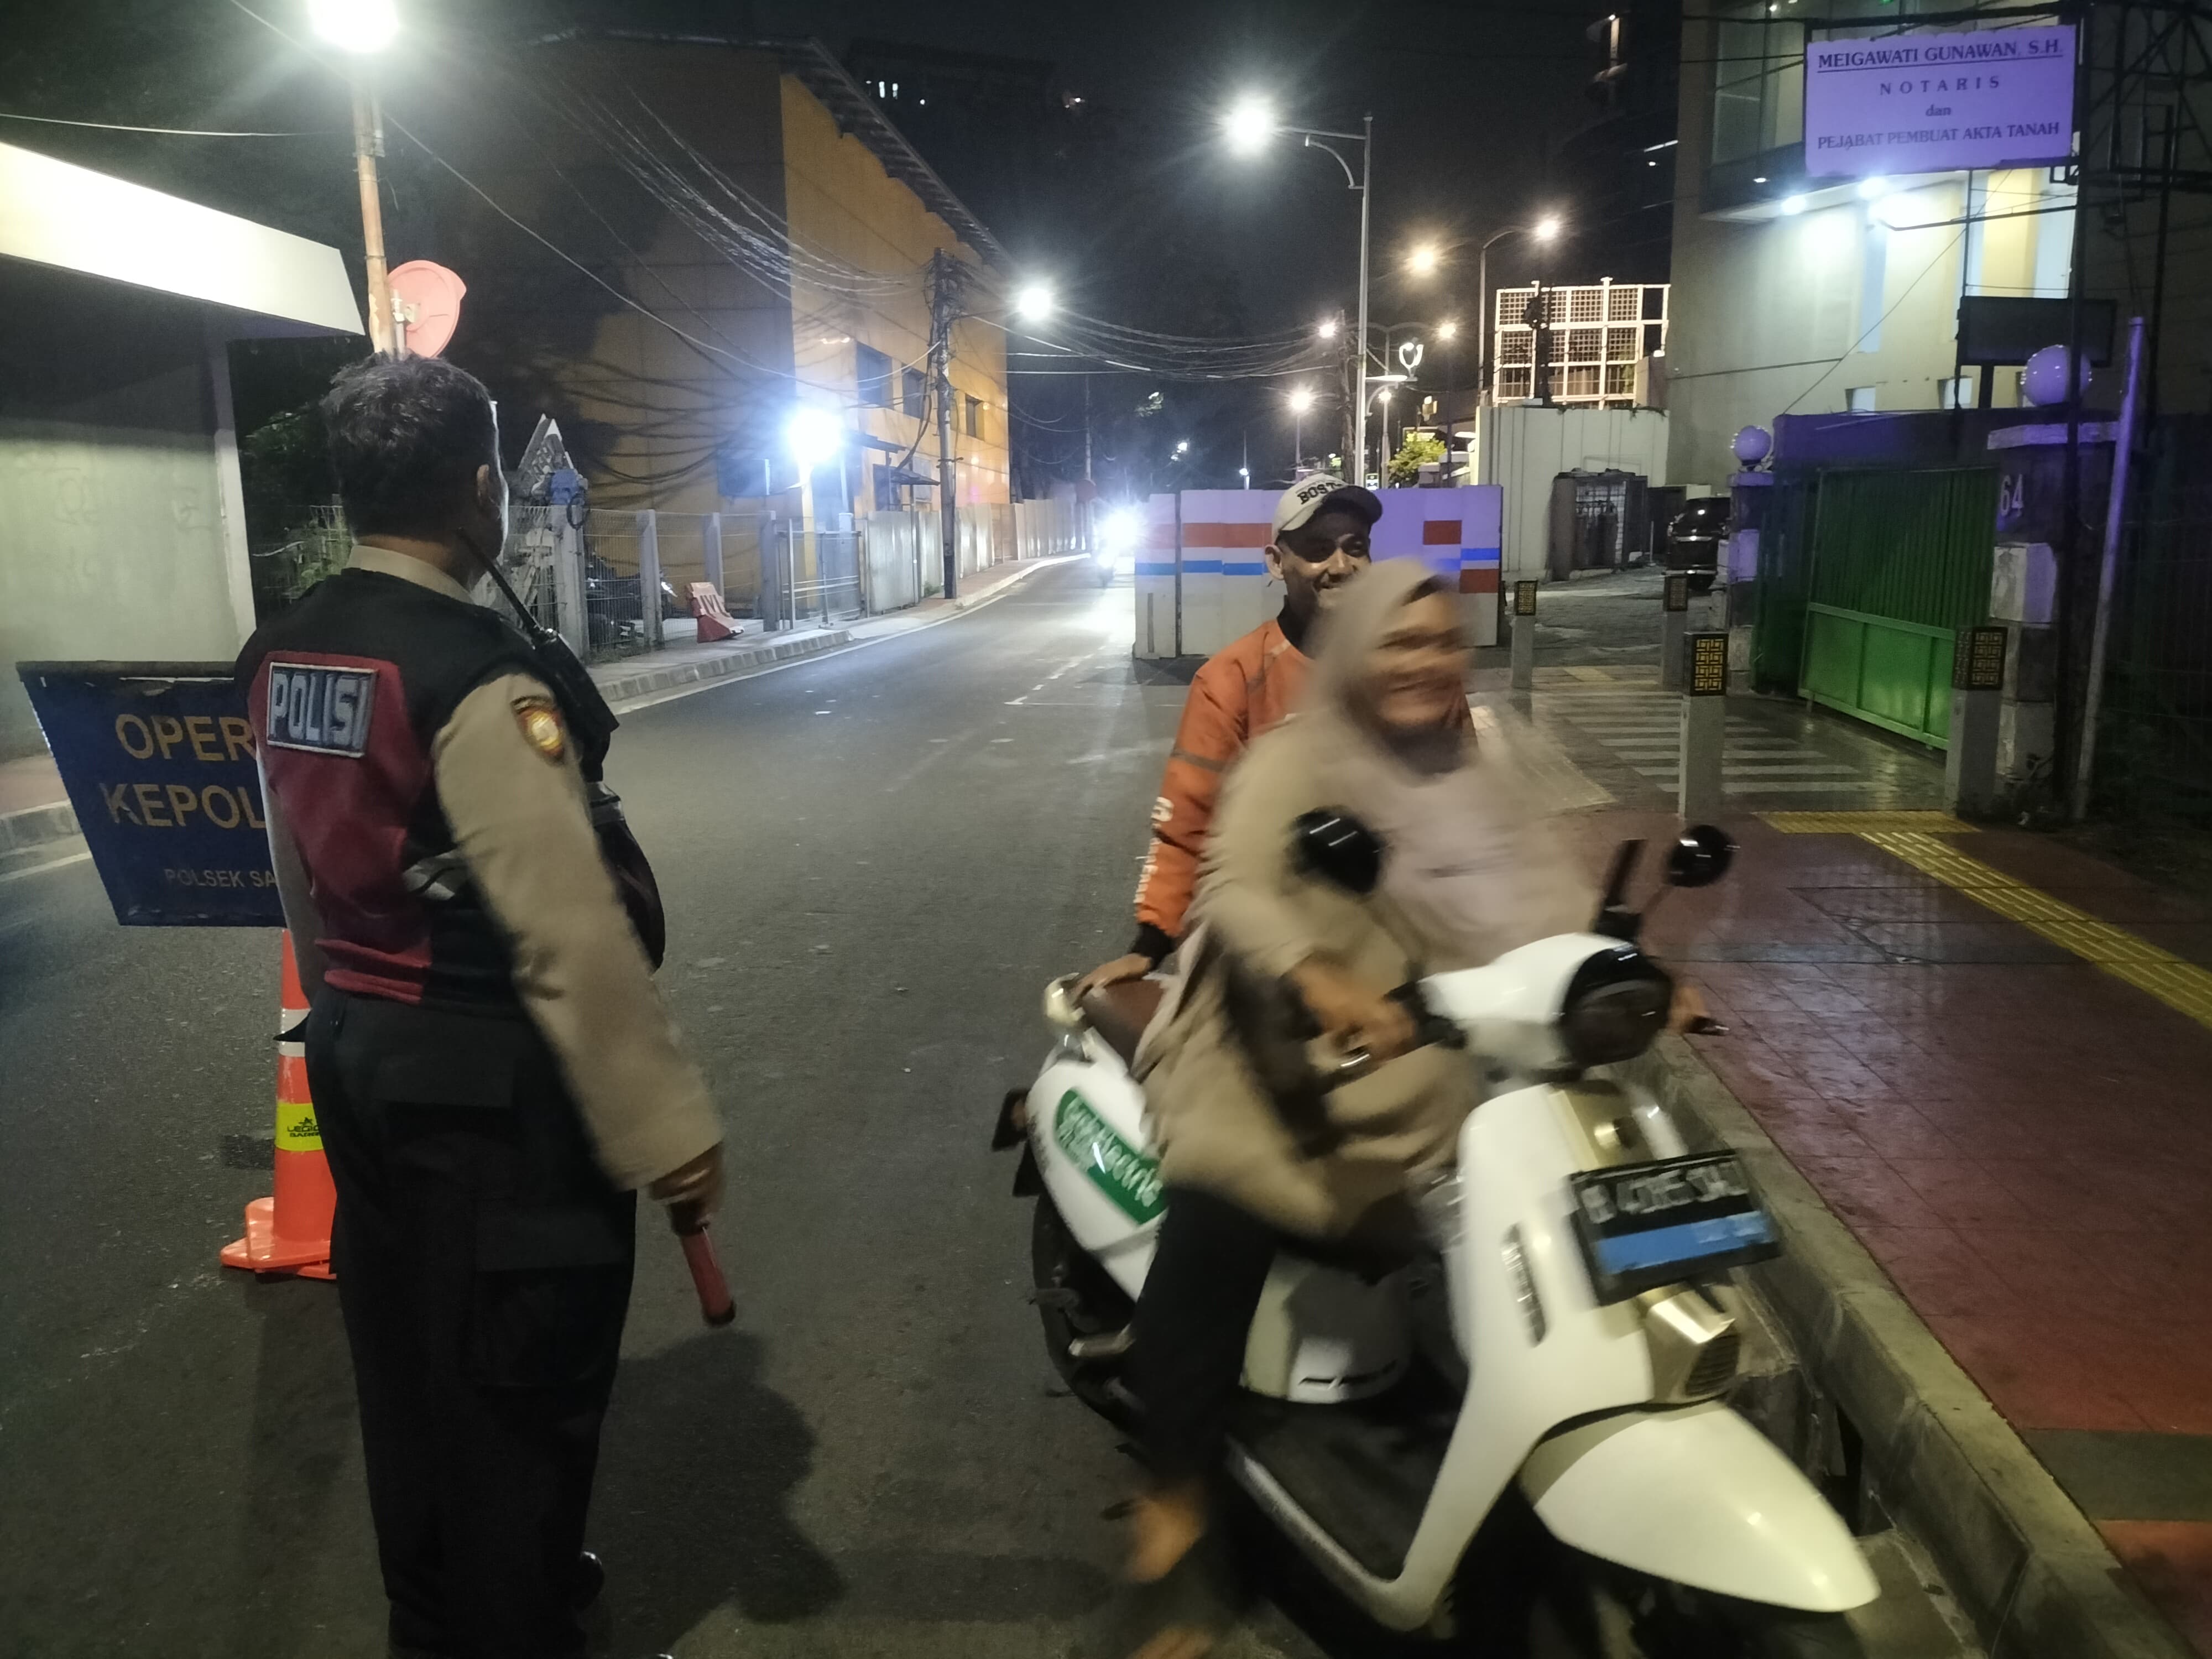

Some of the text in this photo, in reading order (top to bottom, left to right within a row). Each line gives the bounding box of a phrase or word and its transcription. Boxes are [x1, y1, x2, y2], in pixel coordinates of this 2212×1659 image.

[1818, 48, 1918, 68] MEIGAWATI
[1926, 104, 1952, 117] dan
[1818, 122, 2060, 150] PEJABAT PEMBUAT AKTA TANAH
[2000, 474, 2024, 517] 64
[269, 672, 371, 750] POLISI
[164, 868, 246, 888] POLSEK
